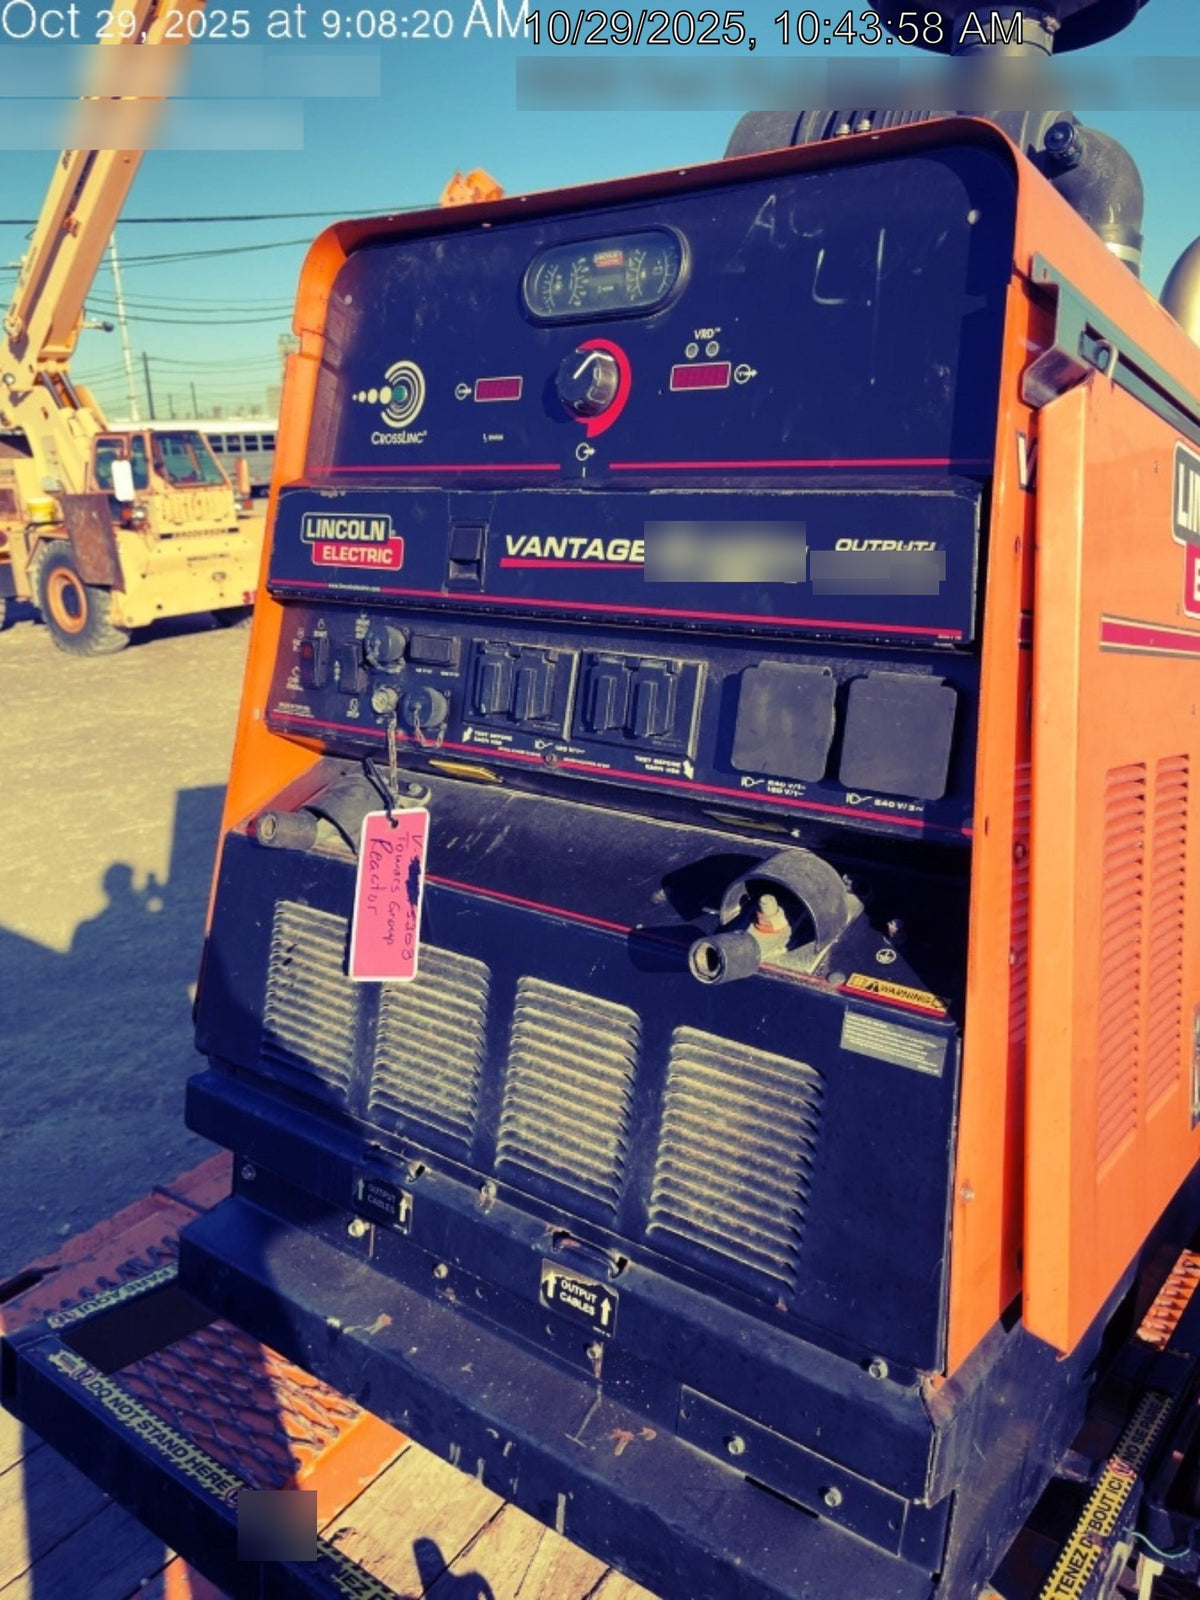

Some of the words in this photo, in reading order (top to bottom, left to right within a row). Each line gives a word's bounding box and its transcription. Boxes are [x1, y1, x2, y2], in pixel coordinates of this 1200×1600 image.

[306, 518, 386, 541] LINCOLN
[322, 545, 394, 564] ELECTRIC
[504, 534, 645, 562] VANTAGE
[560, 1292, 596, 1316] CABLES
[561, 1280, 598, 1304] OUTPUT
[88, 1380, 113, 1398] DO
[108, 1397, 143, 1420] NOT
[137, 1418, 189, 1459] STAND
[184, 1454, 233, 1492] HERE
[1054, 1548, 1089, 1595] TENEZ
[1079, 1493, 1113, 1549] DBOUT
